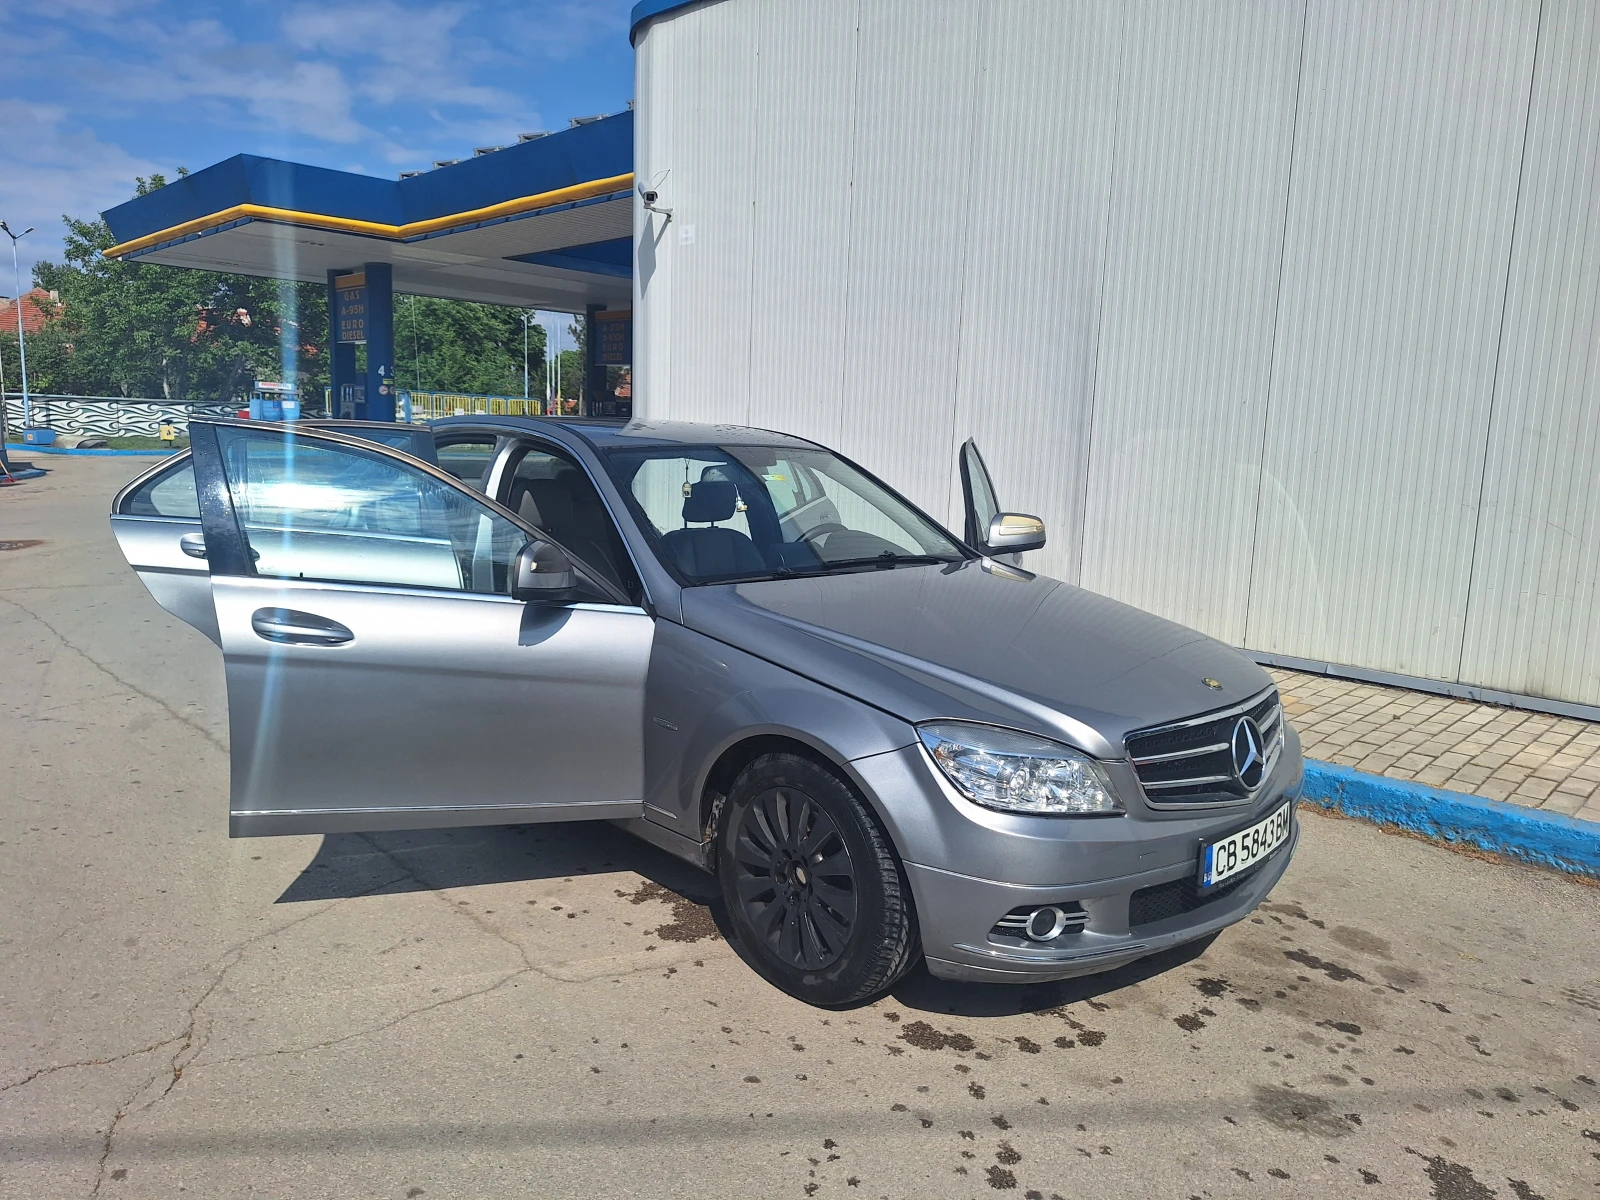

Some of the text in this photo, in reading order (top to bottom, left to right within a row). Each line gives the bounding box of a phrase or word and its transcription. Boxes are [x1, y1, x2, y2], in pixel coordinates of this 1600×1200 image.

[344, 290, 360, 301] GAS
[341, 319, 364, 330] EURO
[342, 330, 364, 340] DIESEL
[378, 365, 385, 376] 4
[1216, 839, 1237, 876] CB
[1241, 818, 1275, 862] 5843
[1275, 805, 1289, 842] BM
